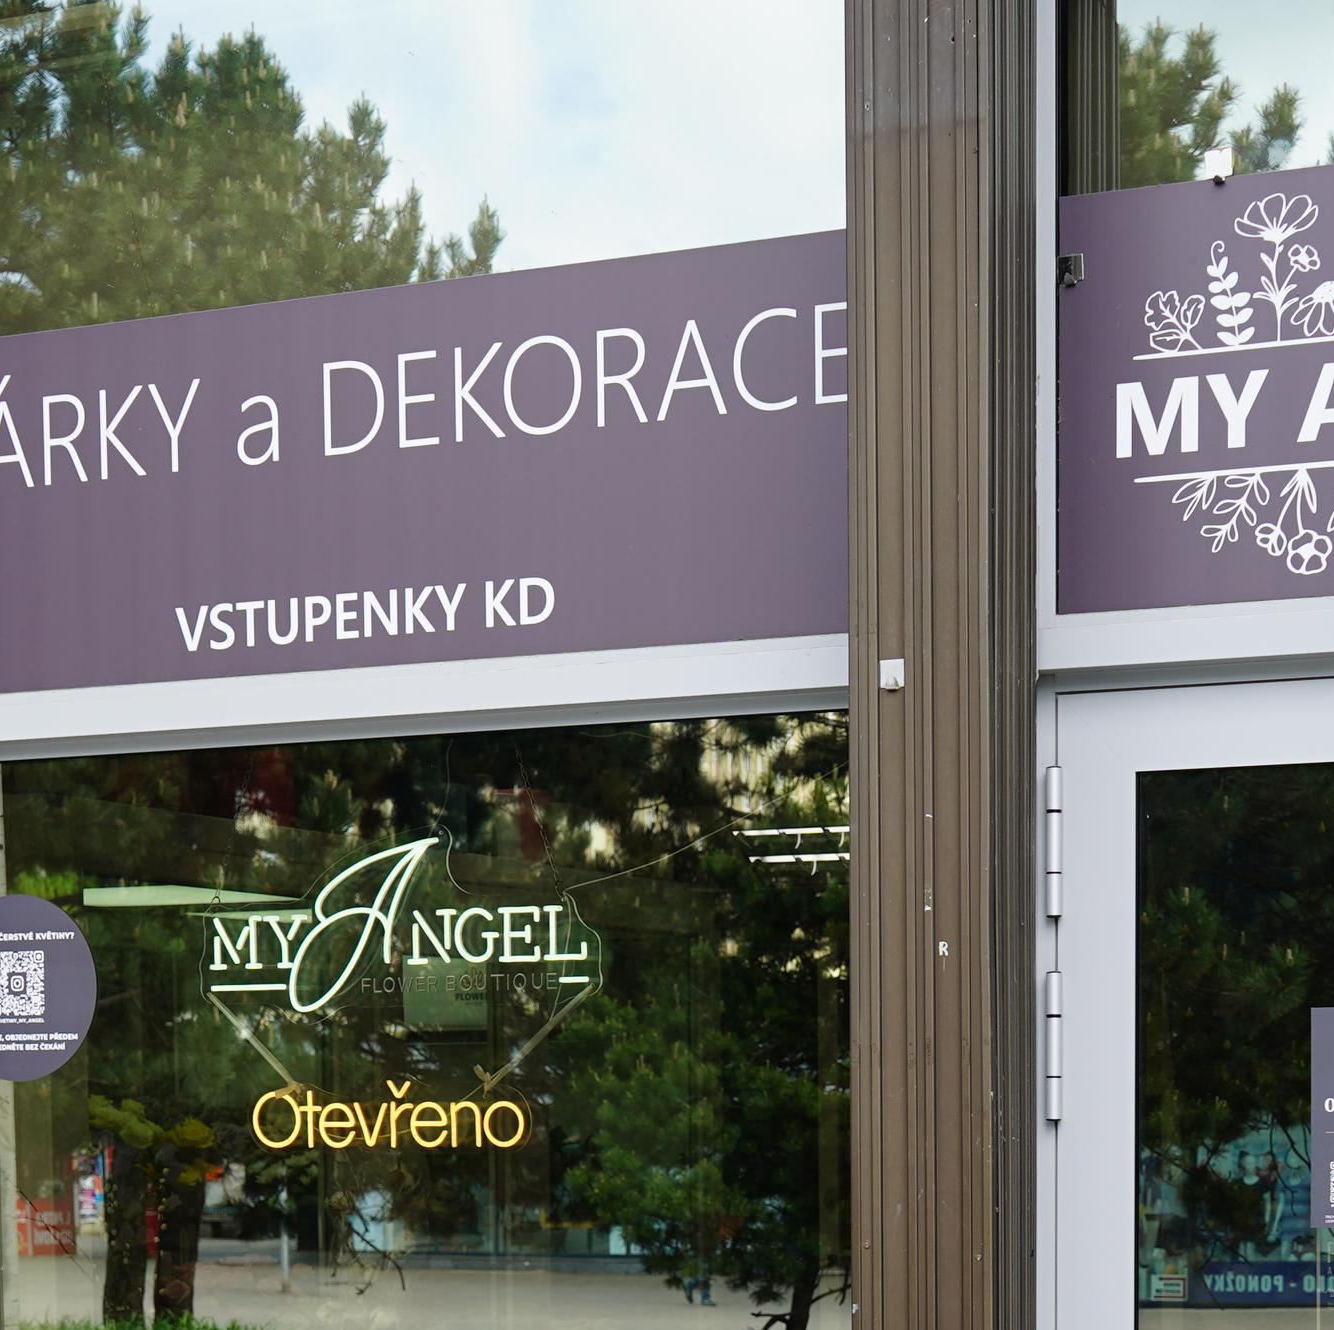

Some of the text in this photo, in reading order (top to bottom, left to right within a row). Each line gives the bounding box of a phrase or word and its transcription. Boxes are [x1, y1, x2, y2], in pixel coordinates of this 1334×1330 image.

[236, 394, 280, 467] a
[323, 301, 848, 458] DEKORACE
[1116, 368, 1269, 459] MY
[175, 577, 555, 654] VSTUPENKY KD
[35, 930, 75, 941] KVĚTINY?
[209, 837, 587, 1013] MY ANGEL
[361, 972, 558, 993] FLOWER BOUTIQUE
[5, 1033, 49, 1041] OBJEDNEJTE
[49, 1032, 79, 1041] PŘEDEM
[25, 1043, 39, 1051] BEZ
[39, 1042, 66, 1051] ČEKÁNÍ
[252, 1080, 525, 1149] Otevřeno
